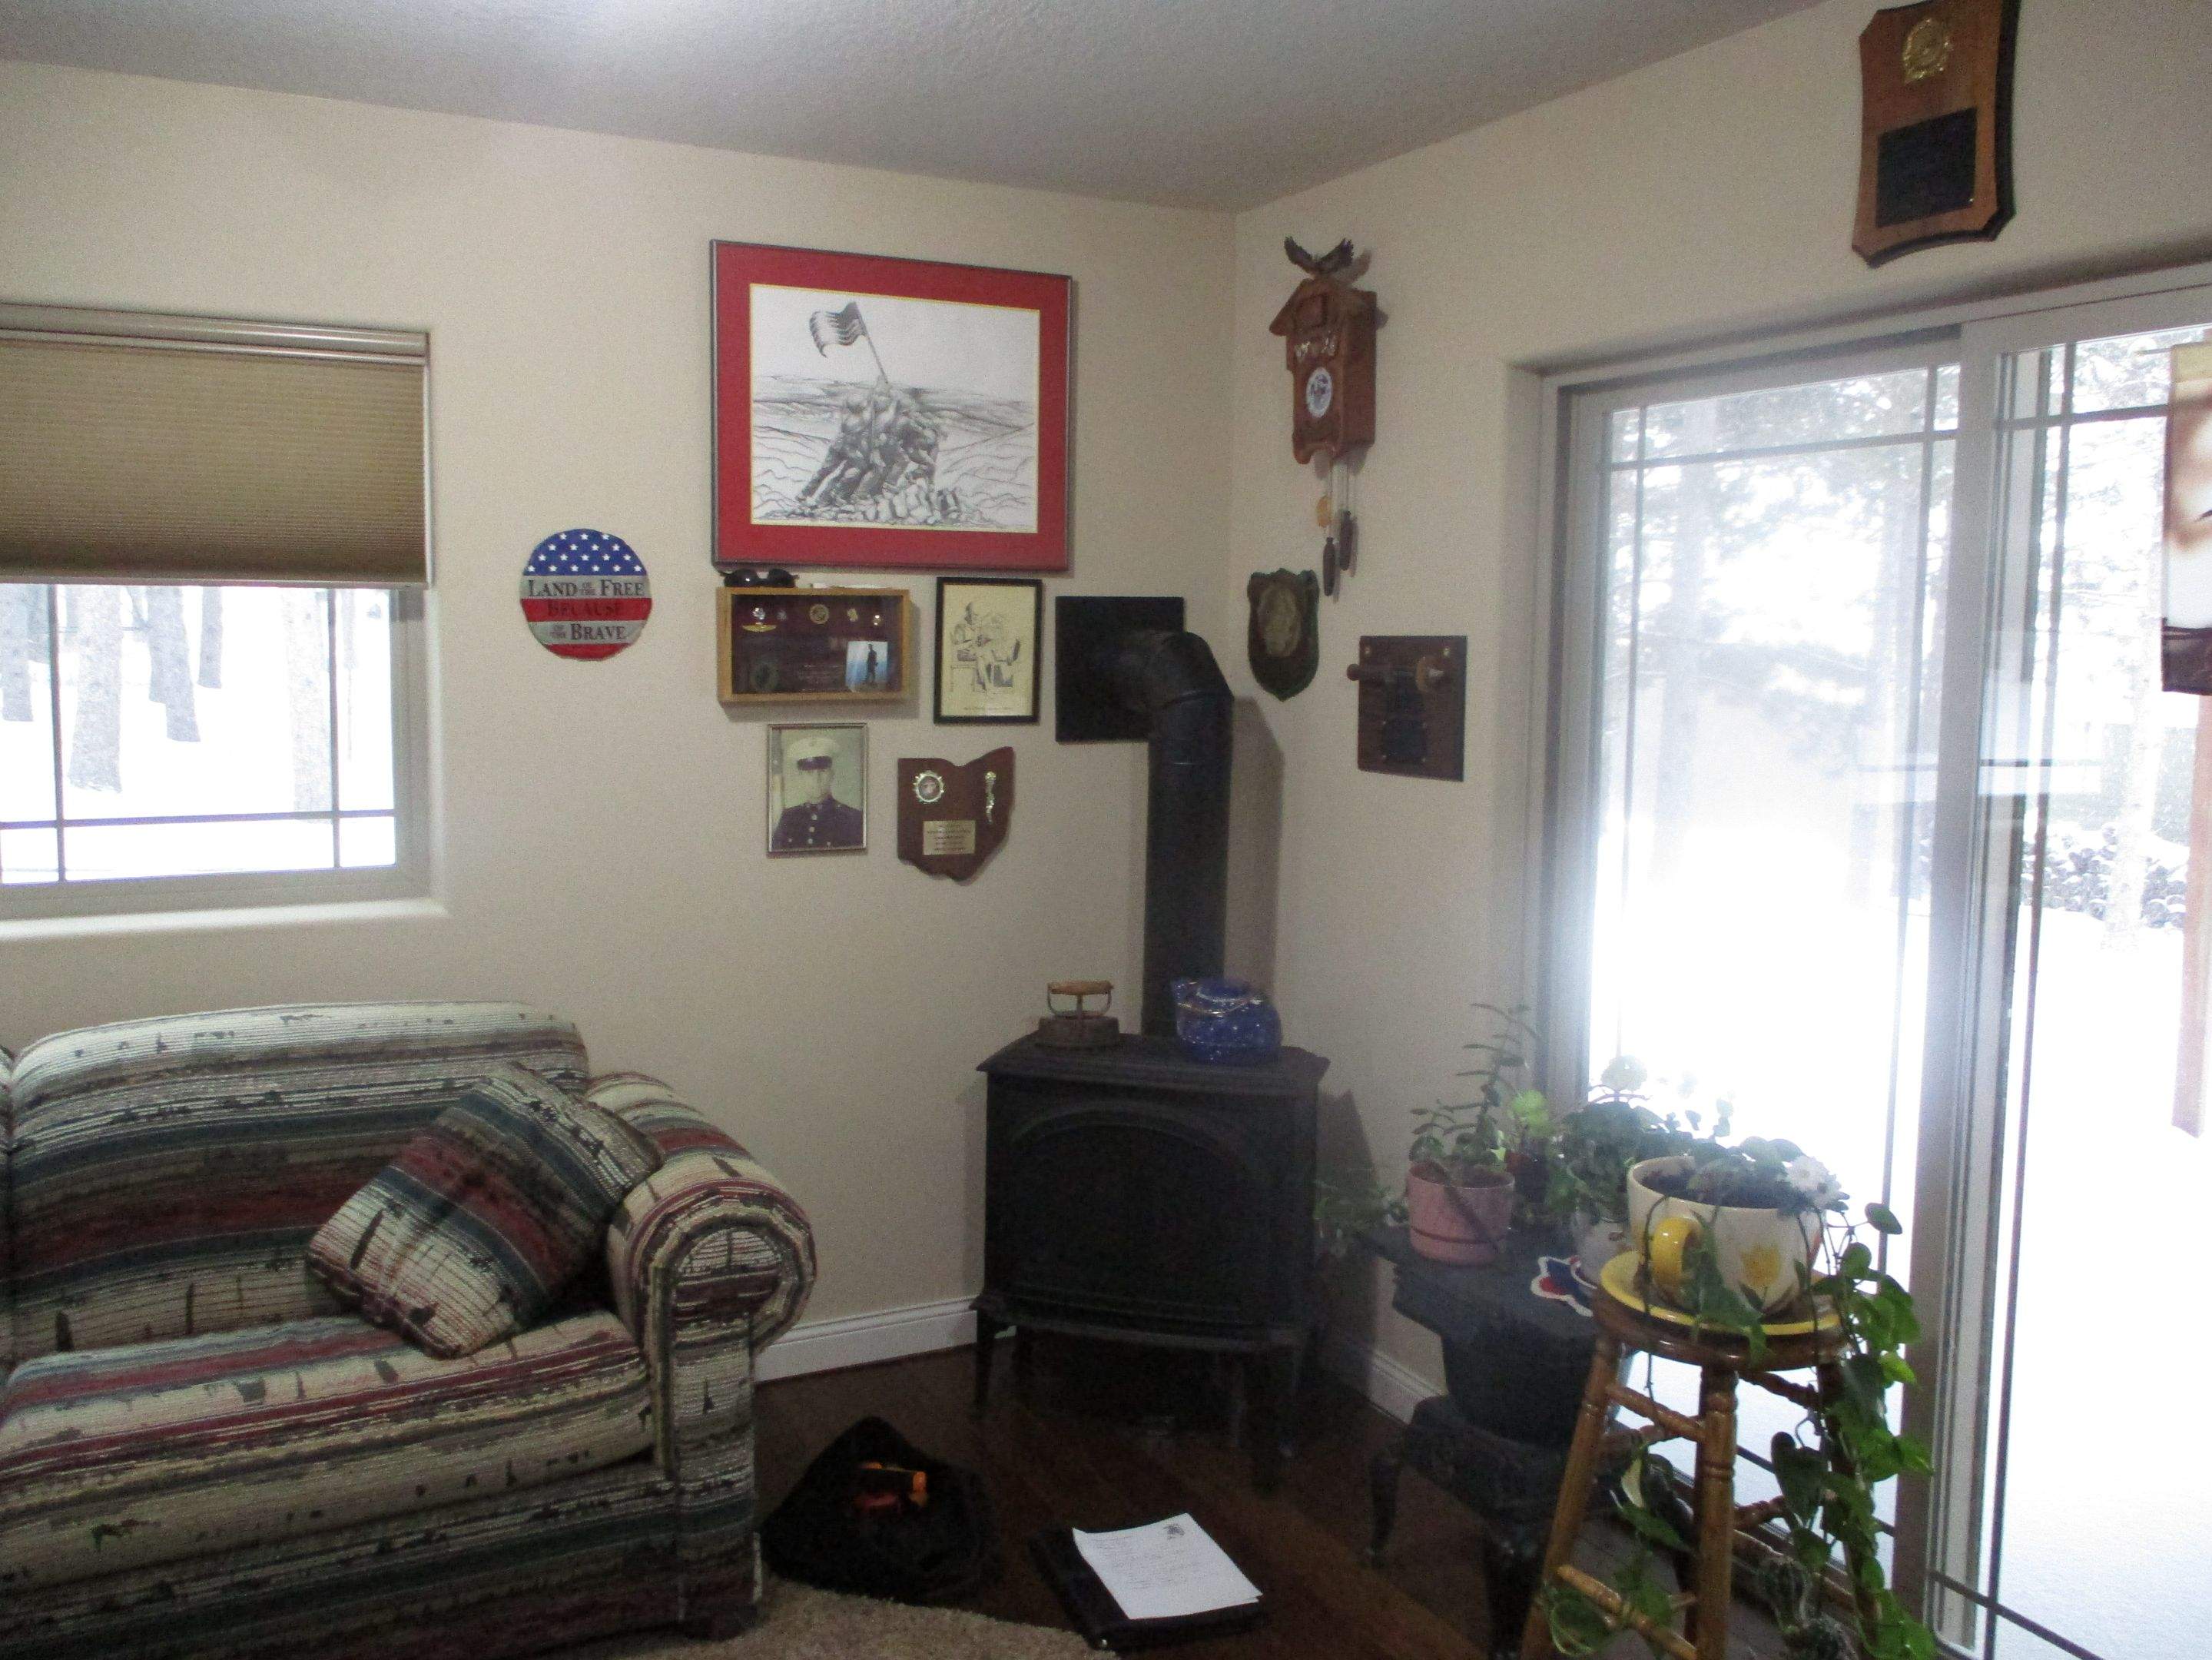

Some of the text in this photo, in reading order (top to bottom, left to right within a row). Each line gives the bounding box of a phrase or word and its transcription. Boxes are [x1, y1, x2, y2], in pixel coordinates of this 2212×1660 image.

[529, 579, 579, 596] LAND
[600, 579, 645, 596] FREE
[548, 599, 621, 616] BECAUSE
[570, 623, 626, 639] BRAVE
